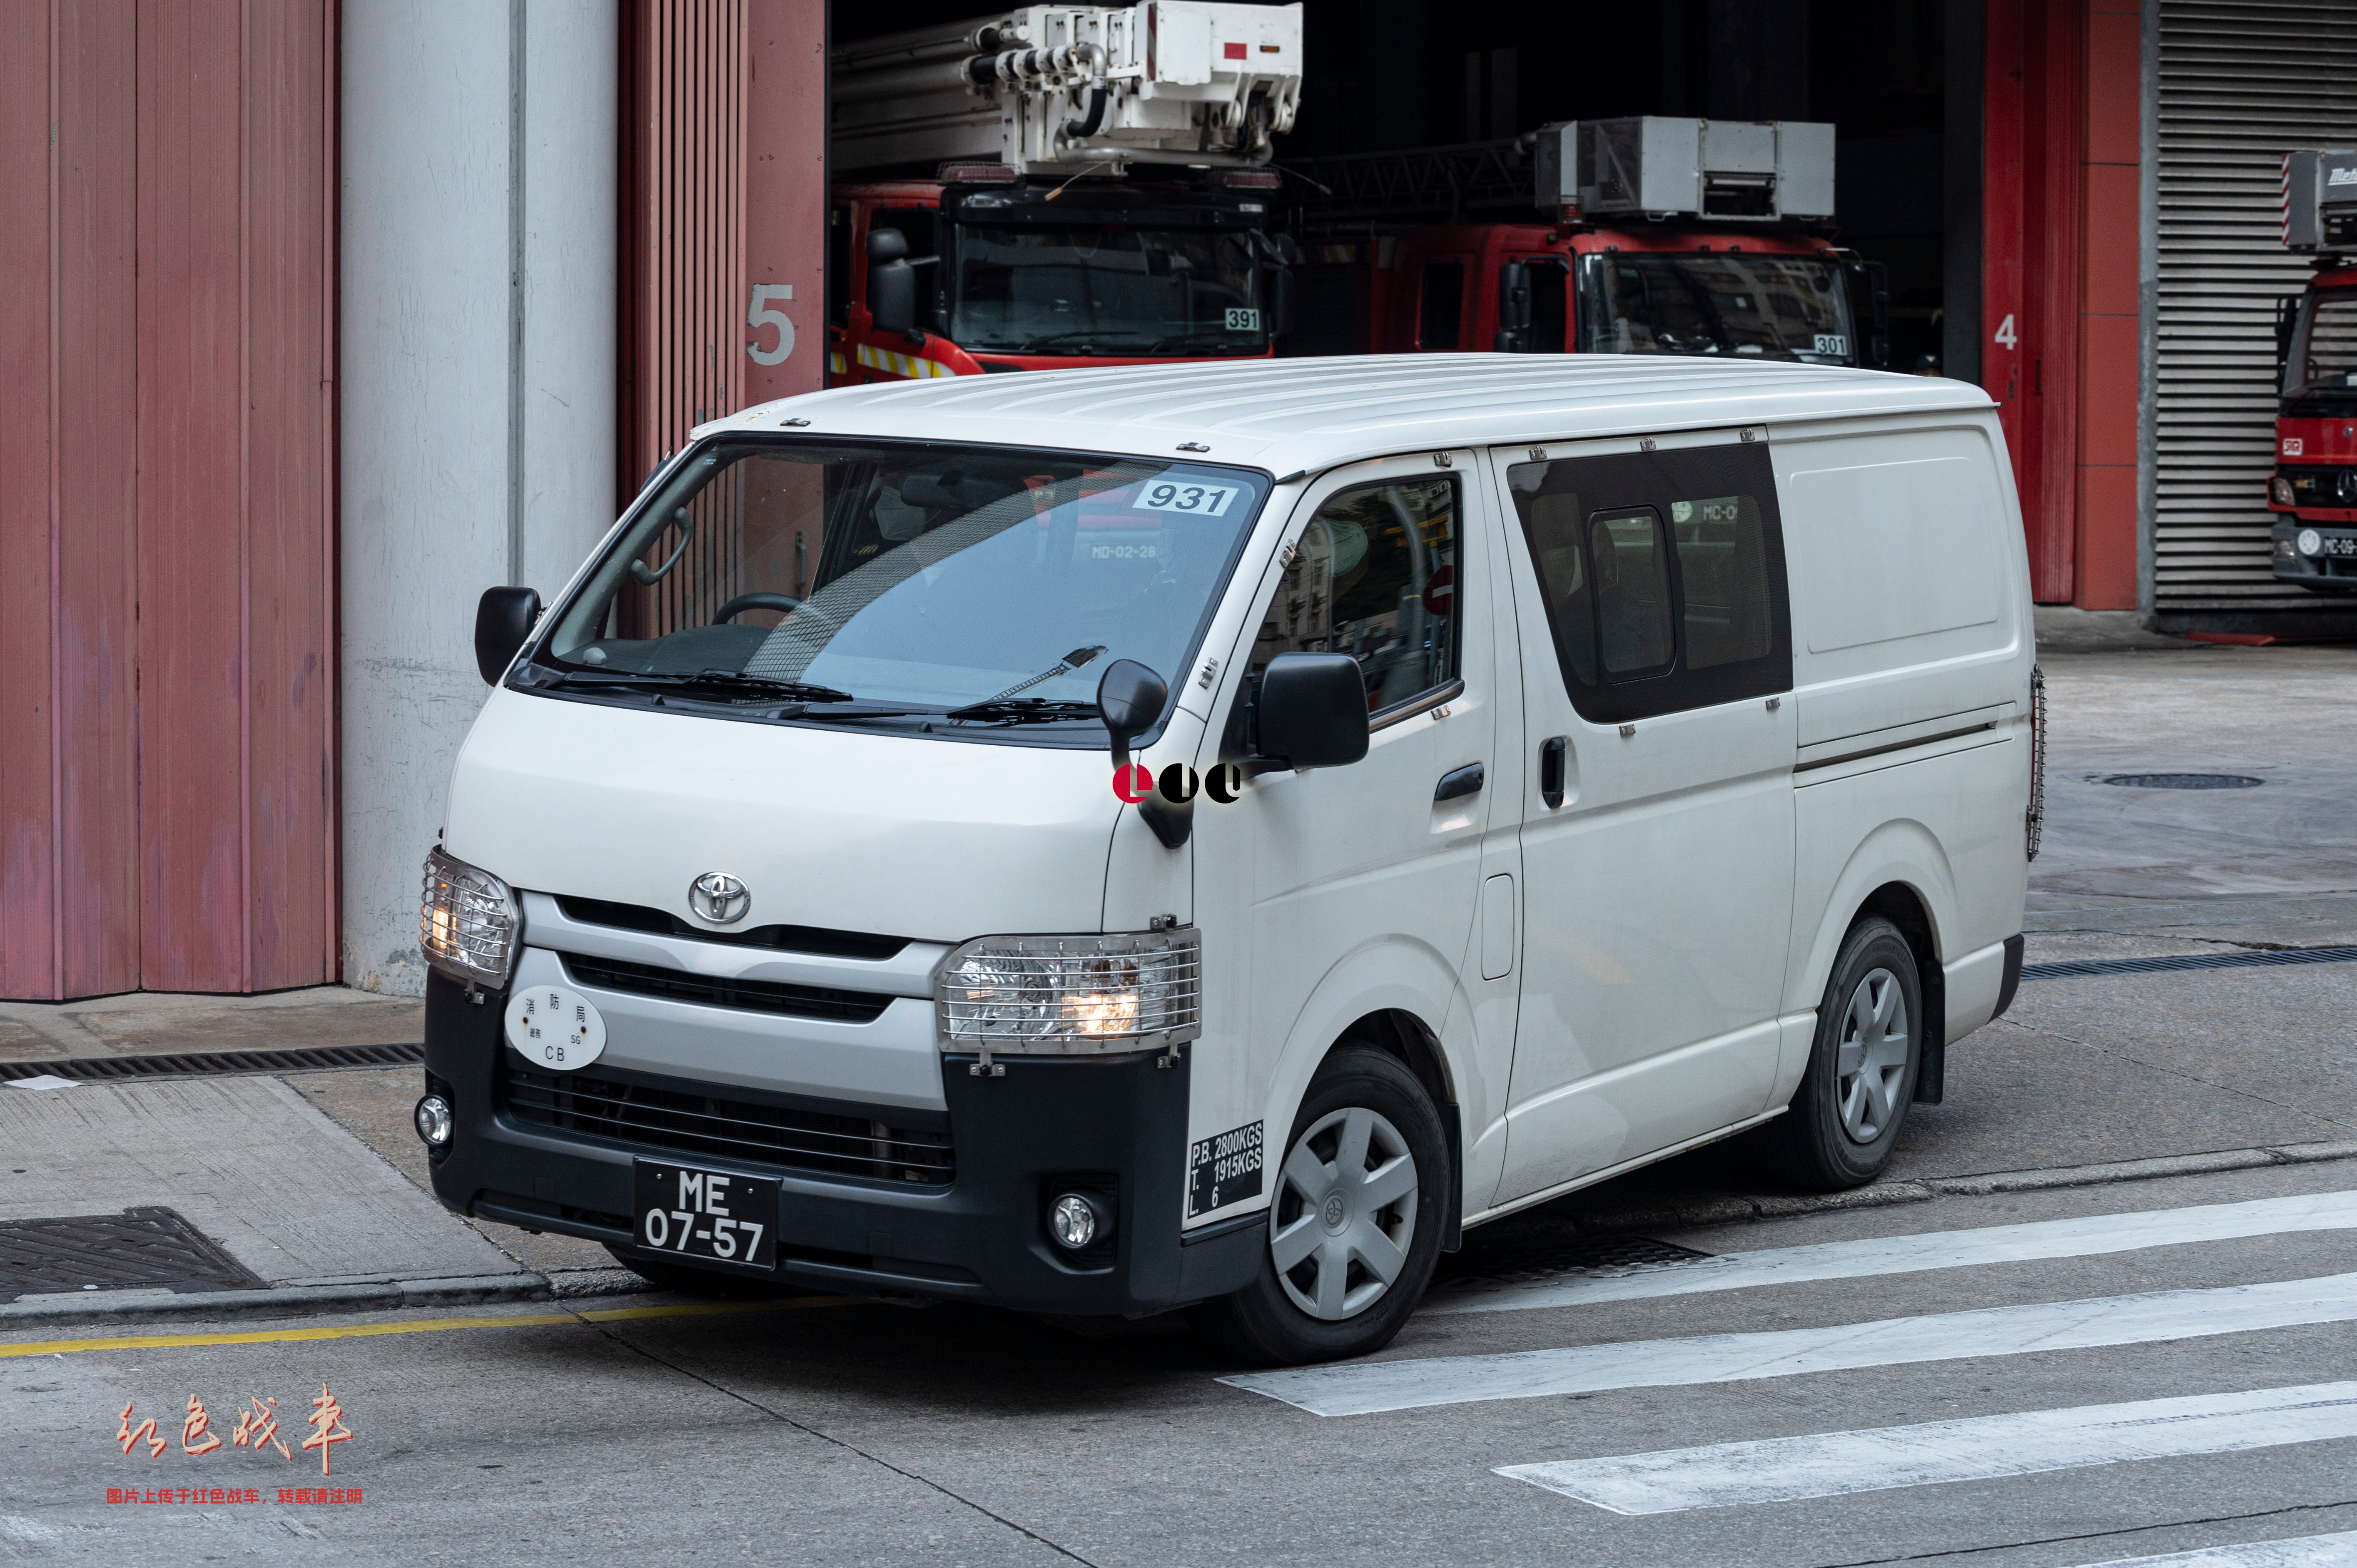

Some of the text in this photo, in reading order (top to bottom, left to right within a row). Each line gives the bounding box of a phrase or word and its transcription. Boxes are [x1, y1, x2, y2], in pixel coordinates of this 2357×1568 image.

[747, 284, 795, 366] 5
[1228, 310, 1257, 329] 391
[1995, 314, 2018, 350] 4
[1818, 337, 1845, 353] 301
[1147, 484, 1227, 513] 931
[1091, 546, 1156, 559] MD-02-28
[2324, 538, 2357, 554] MC-09-
[571, 1035, 581, 1044] SG
[1192, 1122, 1262, 1167] P.B. 2800KGS
[1191, 1147, 1262, 1191] T. 1915KGS
[679, 1171, 730, 1217] ME
[1189, 1186, 1219, 1216] L. 6
[645, 1208, 764, 1262] 07-57
